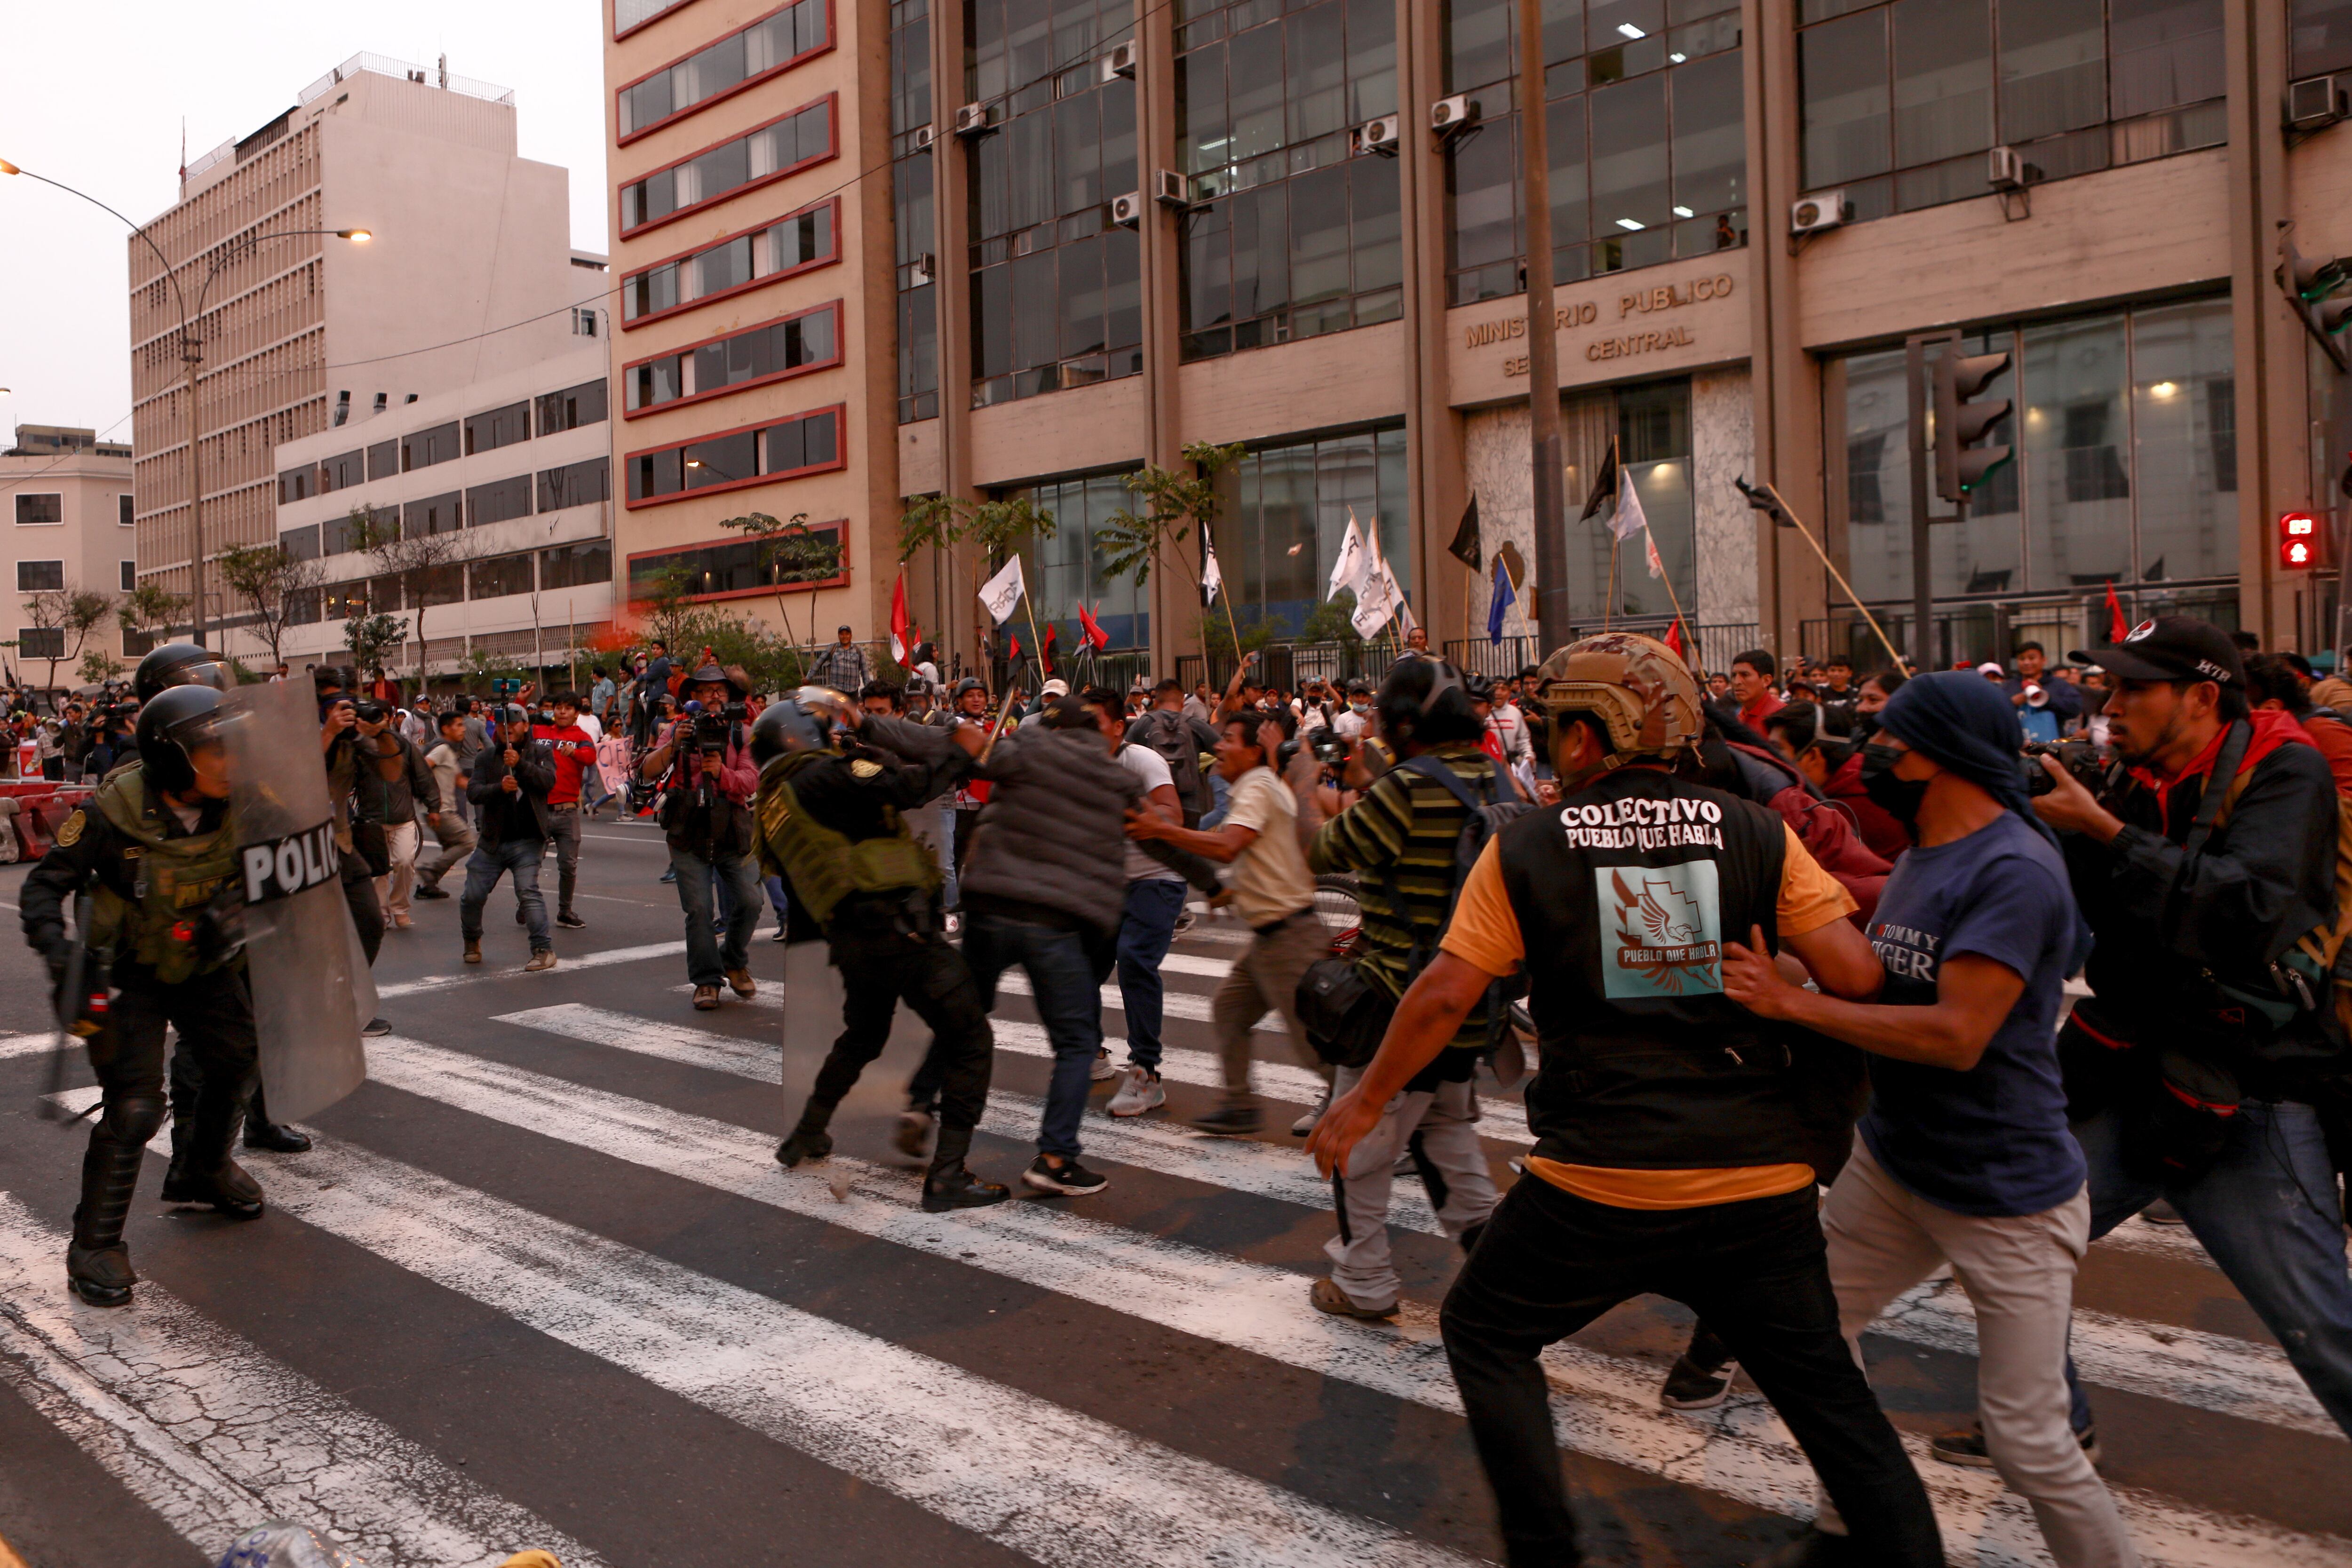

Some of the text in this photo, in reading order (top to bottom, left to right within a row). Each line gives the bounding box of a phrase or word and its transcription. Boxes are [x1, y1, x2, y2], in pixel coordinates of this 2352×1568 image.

[1464, 273, 1733, 349] MINISRIO PUBLICO
[1503, 326, 1694, 377] SE CENTRAL
[1560, 797, 1722, 827] COLECTIVO
[1565, 826, 1636, 849] PUEBLO
[1669, 824, 1724, 850] HABLA
[1882, 924, 1941, 951] TOMMY
[1624, 944, 1716, 963] PUEBLO QUE HABLA
